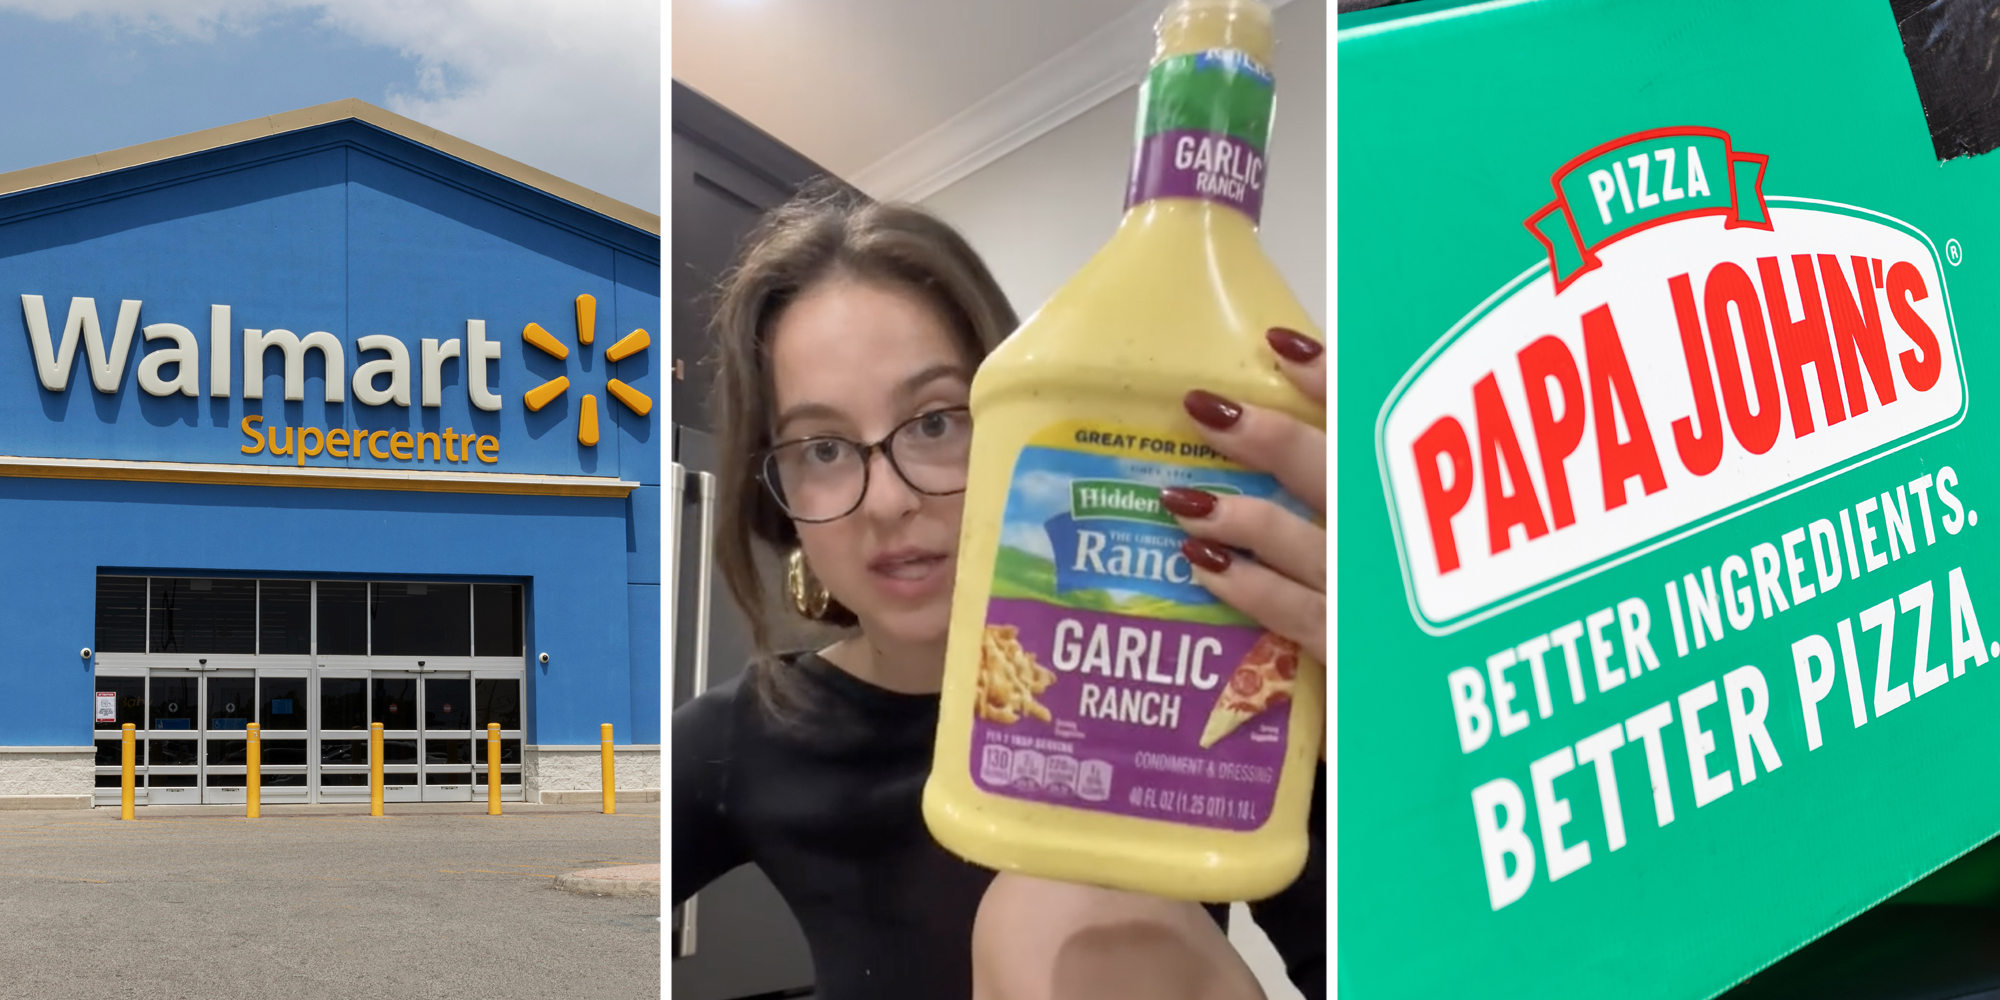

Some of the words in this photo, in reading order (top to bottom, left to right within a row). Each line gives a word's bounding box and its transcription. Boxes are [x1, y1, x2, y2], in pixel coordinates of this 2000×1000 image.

[1174, 136, 1262, 190] GARLIC
[1196, 171, 1246, 202] RANCH
[1588, 146, 1711, 225] PIZZA
[21, 293, 503, 411] Walmart
[240, 414, 500, 466] Supercentre
[1411, 302, 1668, 576] PAPA
[1667, 253, 1943, 477] JOHN'S
[1075, 430, 1136, 450] GREAT
[1139, 437, 1177, 455] FOR
[1179, 442, 1228, 462] DIPP
[1079, 487, 1160, 513] Hidden
[1071, 529, 1198, 584] Ranc
[1448, 597, 1660, 755] BETTER
[1664, 465, 1979, 659] INGREDIENTS.
[1052, 618, 1223, 690] GARLIC
[1079, 682, 1182, 730] RANCH
[986, 748, 1010, 770] 130
[1470, 665, 1784, 912] BETTER
[1791, 566, 2000, 752] PIZZA.
[1135, 751, 1205, 774] CONDIMENT
[1218, 762, 1273, 783] DRESSING
[1159, 790, 1175, 812] OZ
